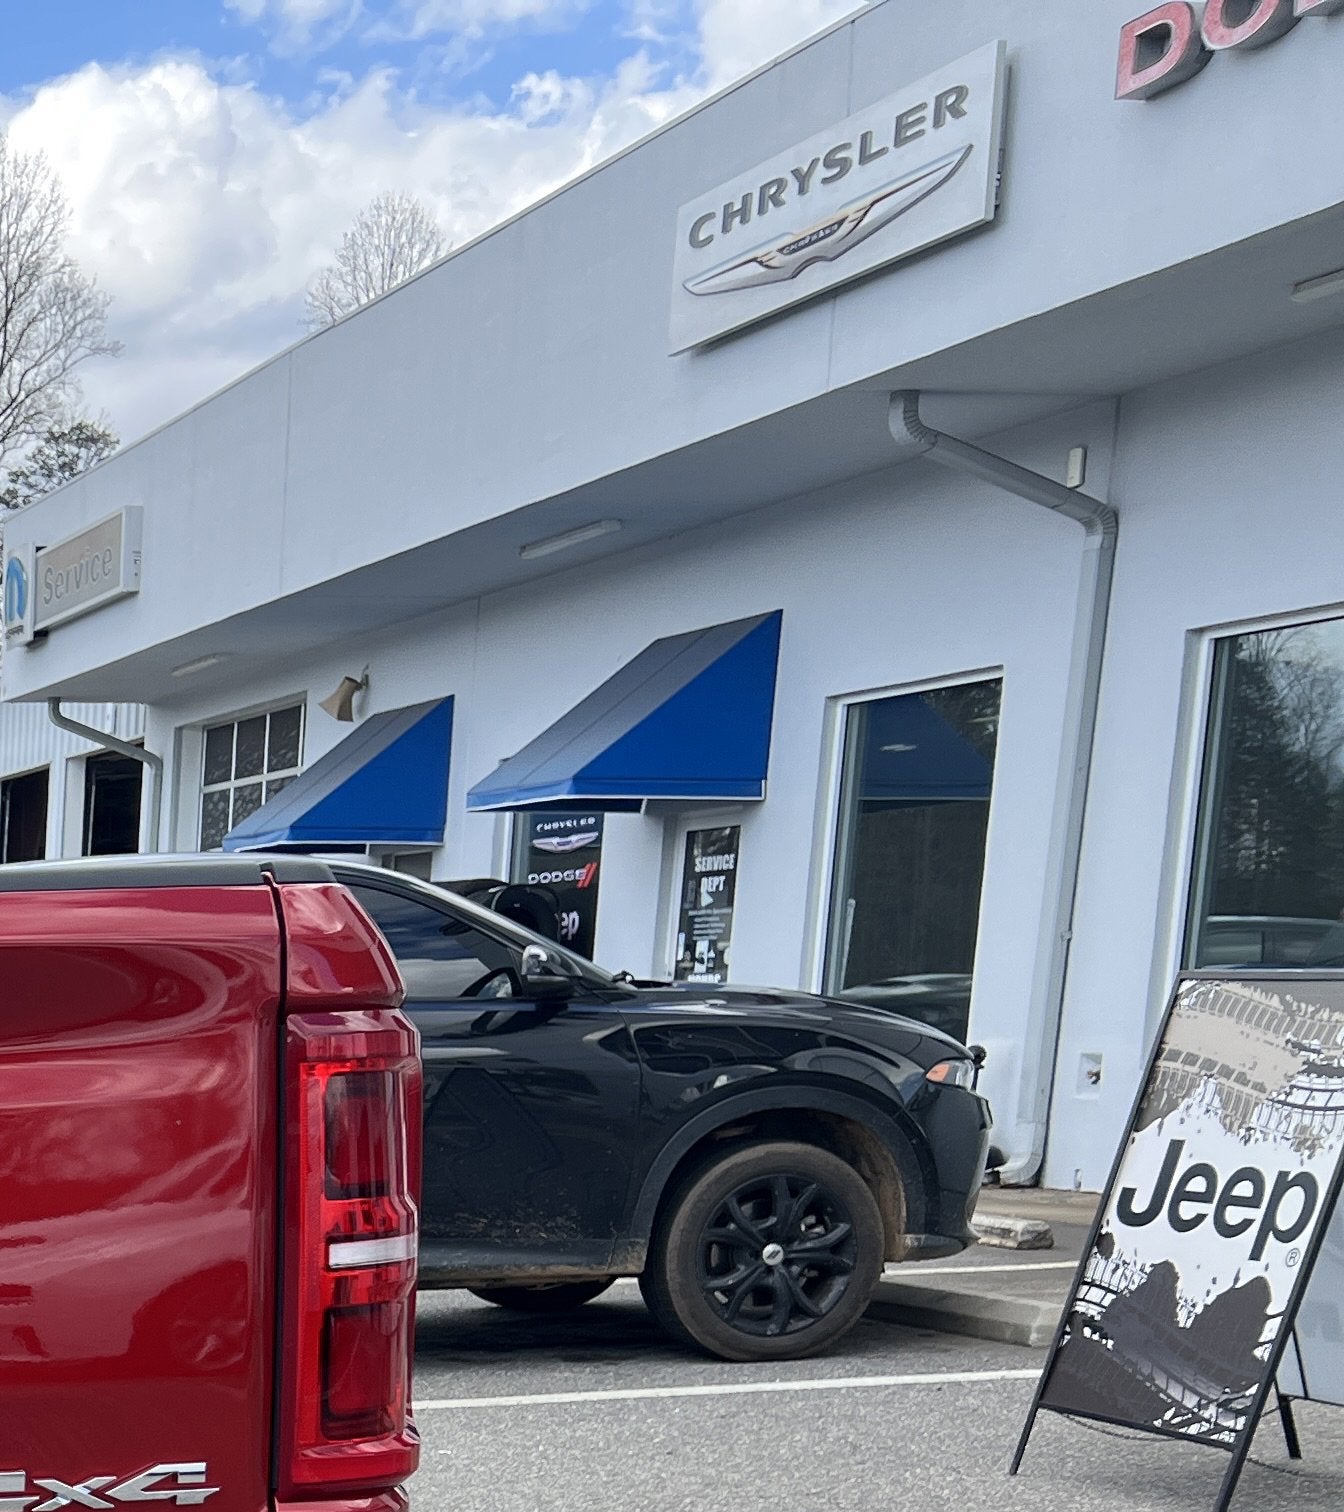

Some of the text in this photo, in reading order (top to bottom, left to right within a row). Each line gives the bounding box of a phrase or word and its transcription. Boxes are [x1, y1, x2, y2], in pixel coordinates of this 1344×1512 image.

[1115, 0, 1344, 100] DO
[688, 85, 970, 249] CHRYSLER
[43, 547, 113, 605] Service
[528, 868, 587, 885] DODGE
[694, 853, 736, 872] SERVICE
[701, 875, 726, 892] DEPT
[560, 911, 580, 940] ep
[1117, 1138, 1320, 1261] Jeep
